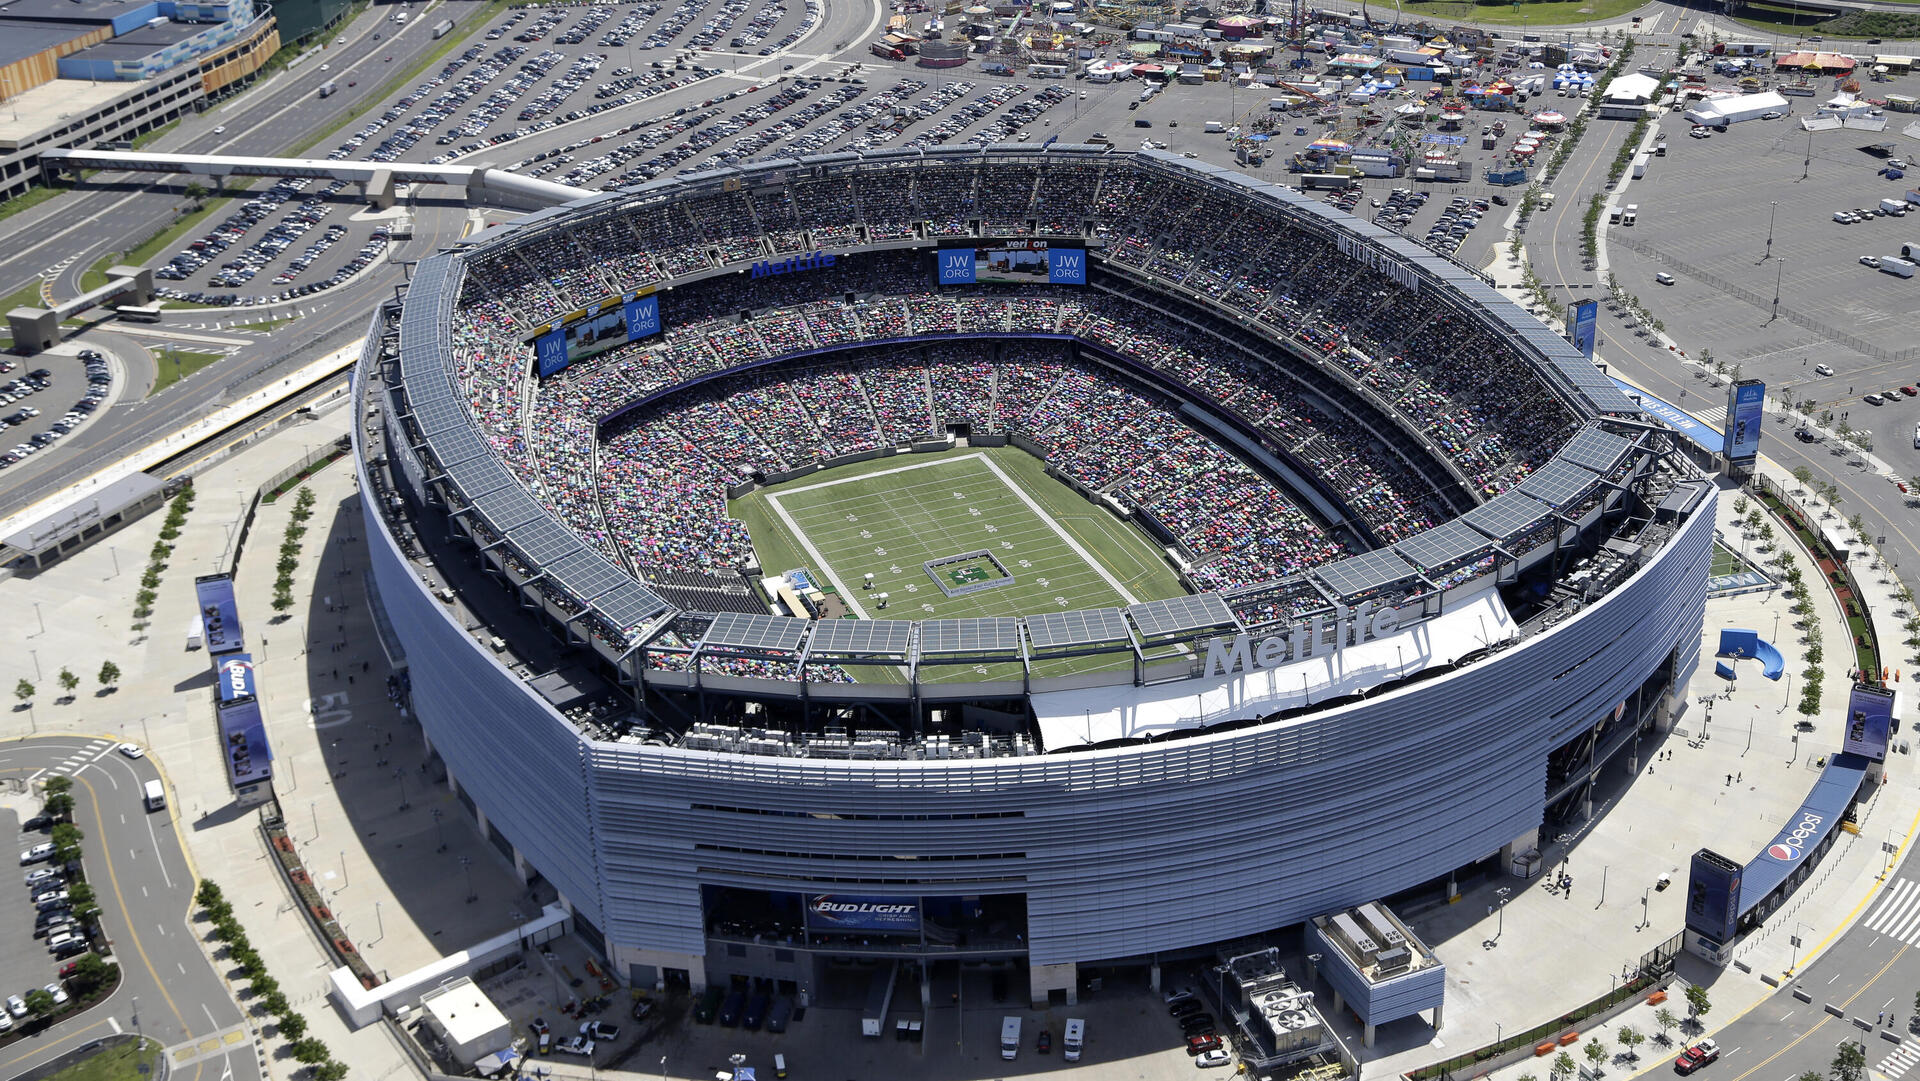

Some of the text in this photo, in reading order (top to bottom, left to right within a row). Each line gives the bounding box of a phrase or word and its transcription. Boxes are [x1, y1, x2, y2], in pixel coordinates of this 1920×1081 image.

[1006, 239, 1047, 248] verizon
[752, 250, 836, 279] MetLife
[945, 255, 969, 268] JW
[1056, 255, 1079, 268] JW
[1337, 233, 1419, 295] METLIFE STADIUM
[944, 268, 970, 278] .ORG
[1054, 268, 1080, 278] .ORG
[632, 304, 653, 322] JW
[631, 318, 655, 334] .ORG
[543, 338, 561, 358] JW
[543, 353, 563, 369] .ORG
[1656, 407, 1697, 429] METLIFE
[1203, 599, 1400, 679] MetLife
[230, 665, 246, 690] BUD
[1785, 812, 1824, 849] pepsi
[817, 902, 915, 913] BUD LIGHT
[1728, 894, 1737, 925] pepsi
